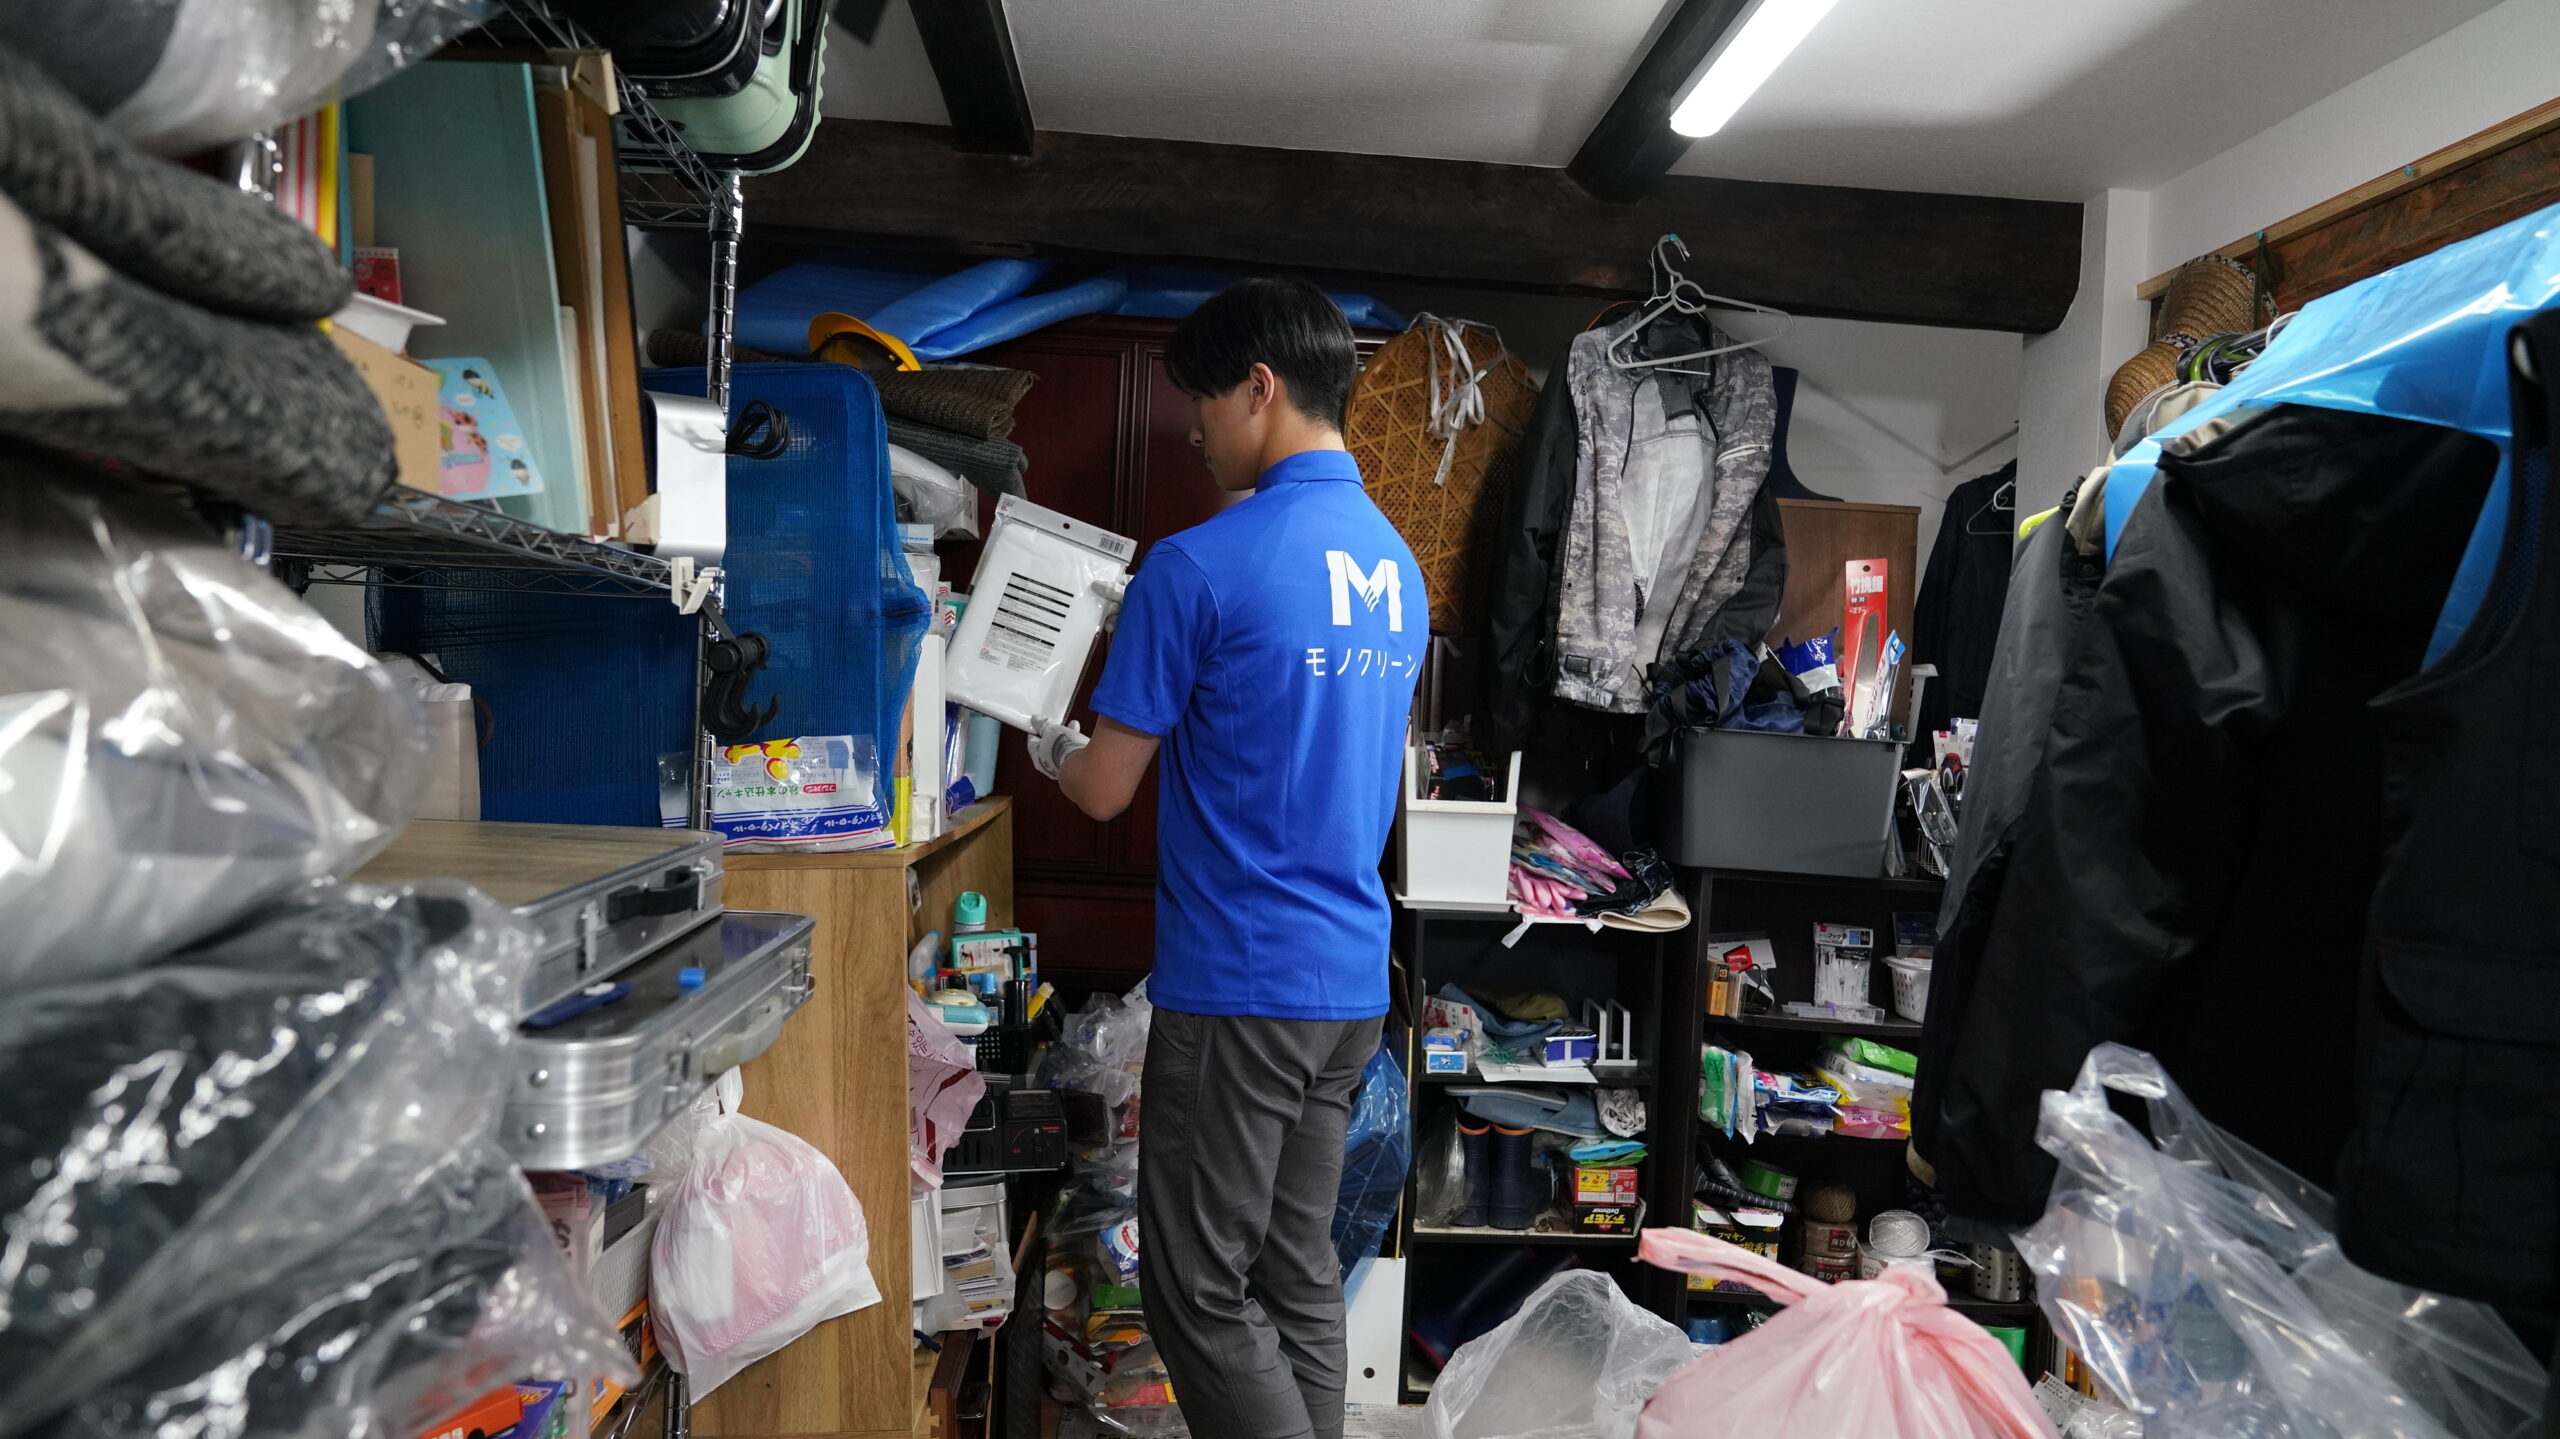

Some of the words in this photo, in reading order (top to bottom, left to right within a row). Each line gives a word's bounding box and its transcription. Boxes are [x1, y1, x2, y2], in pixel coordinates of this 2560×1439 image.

[1325, 550, 1402, 632] M
[1305, 648, 1417, 679] モノクリーン
[1583, 1213, 1627, 1225] デスモア
